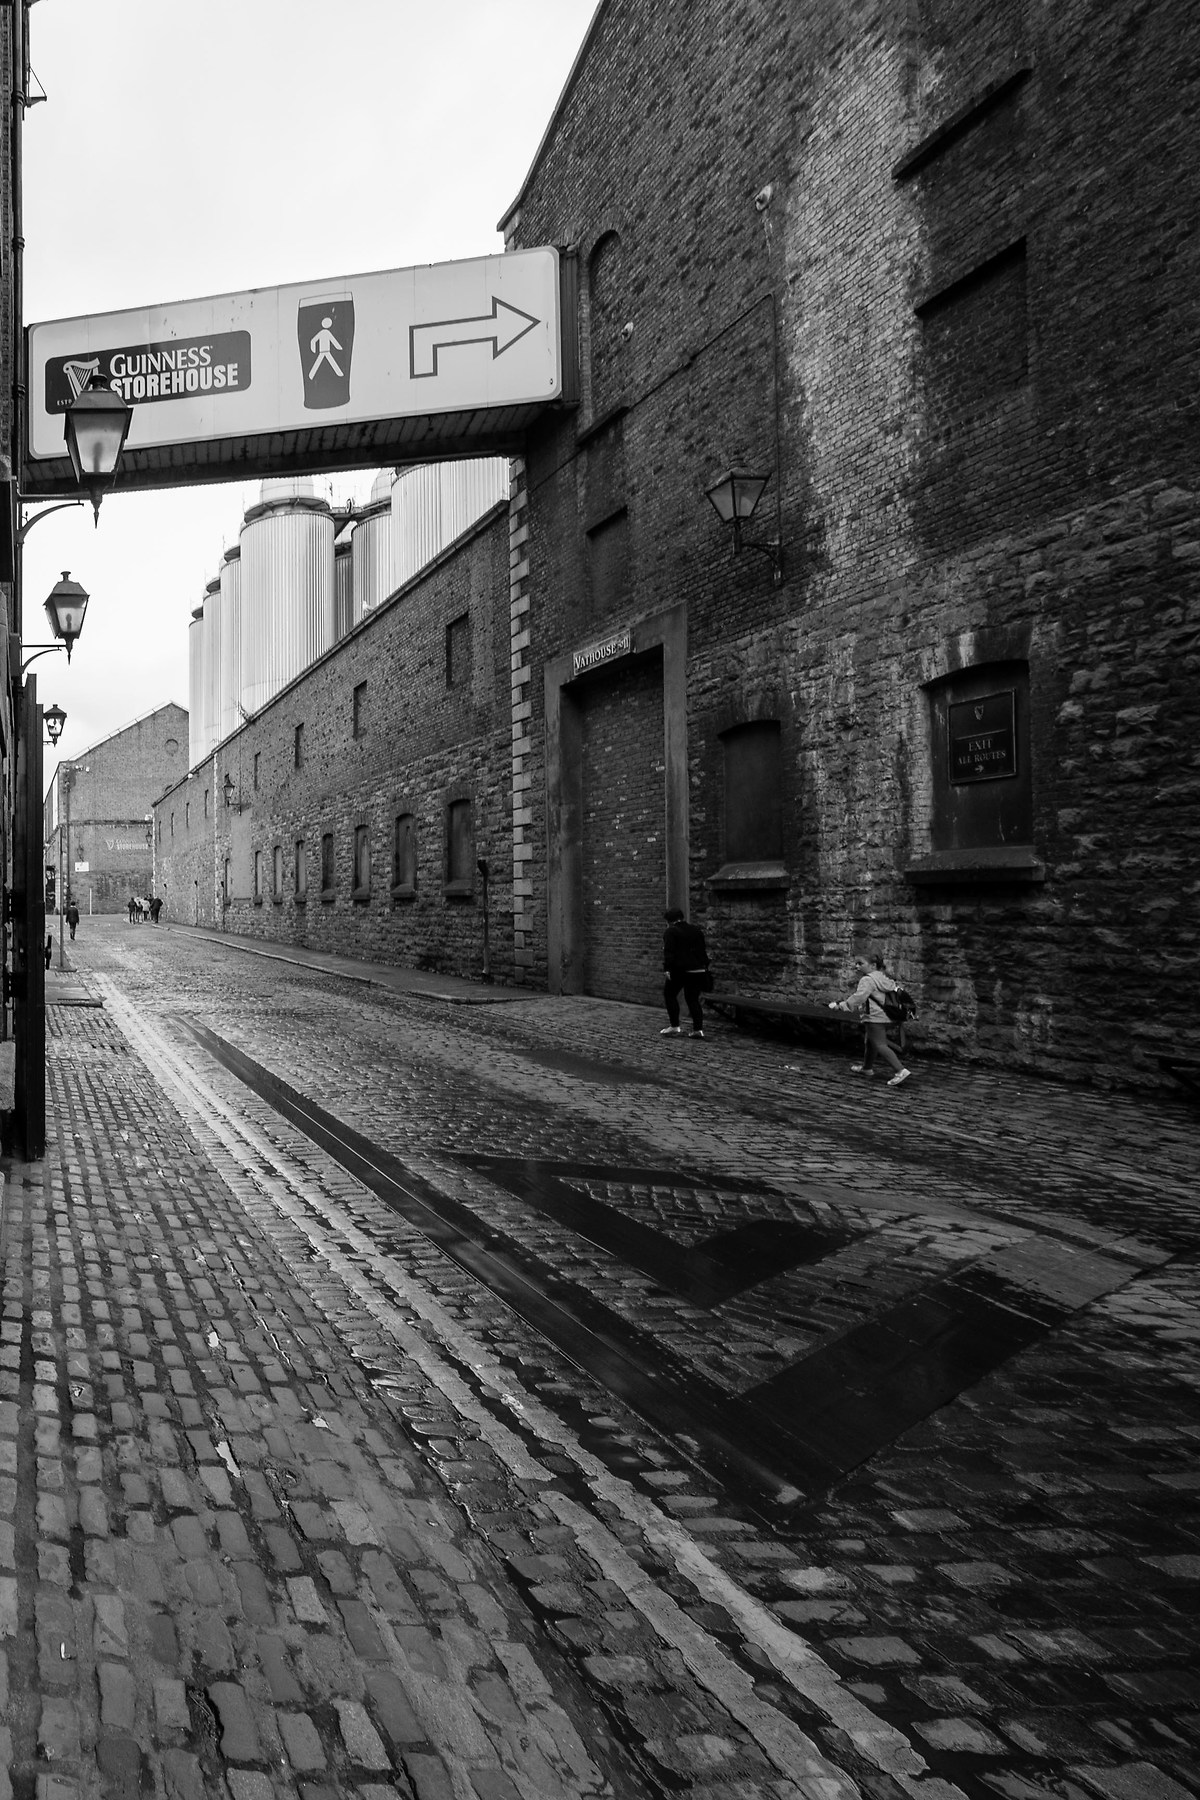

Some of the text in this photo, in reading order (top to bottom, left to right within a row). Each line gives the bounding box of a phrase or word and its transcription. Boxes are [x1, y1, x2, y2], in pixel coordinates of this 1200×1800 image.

[110, 345, 212, 377] GUINNESS
[110, 363, 239, 400] STOREHOUSE
[575, 643, 617, 669] VATHOUSE
[958, 750, 1007, 765] ALL ROUTES
[968, 738, 992, 752] EXIT
